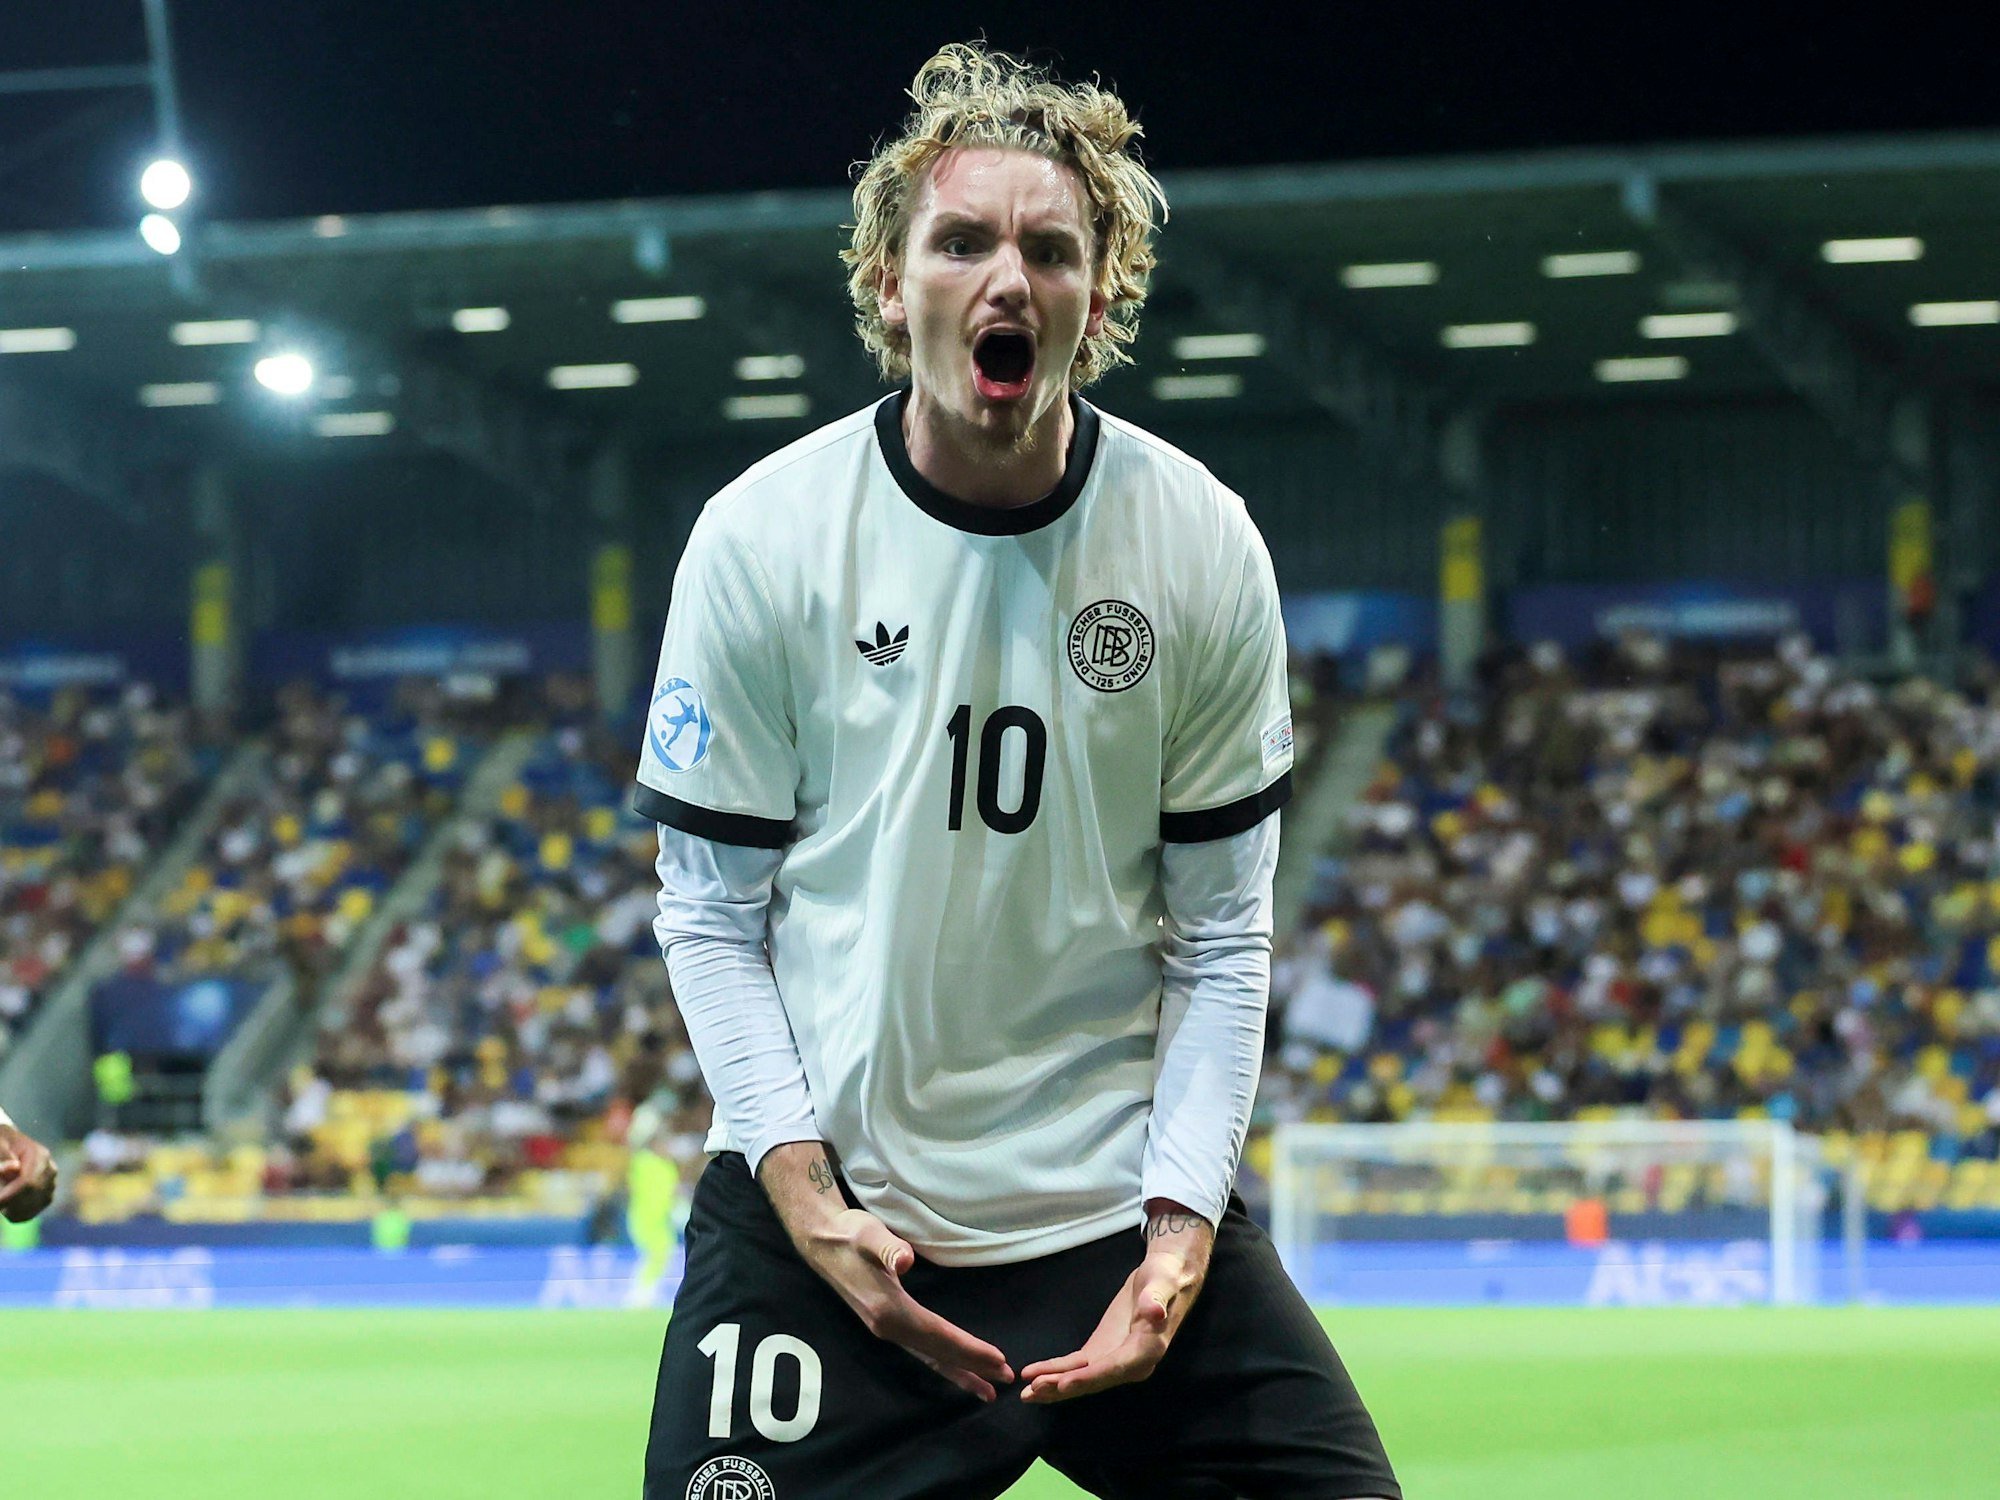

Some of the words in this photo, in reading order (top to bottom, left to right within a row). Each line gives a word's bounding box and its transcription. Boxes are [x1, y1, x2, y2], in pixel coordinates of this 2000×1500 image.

[1072, 606, 1102, 676] DEUTSCHER
[1095, 676, 1115, 688] 125
[946, 704, 1047, 835] 10
[696, 1322, 823, 1443] 10
